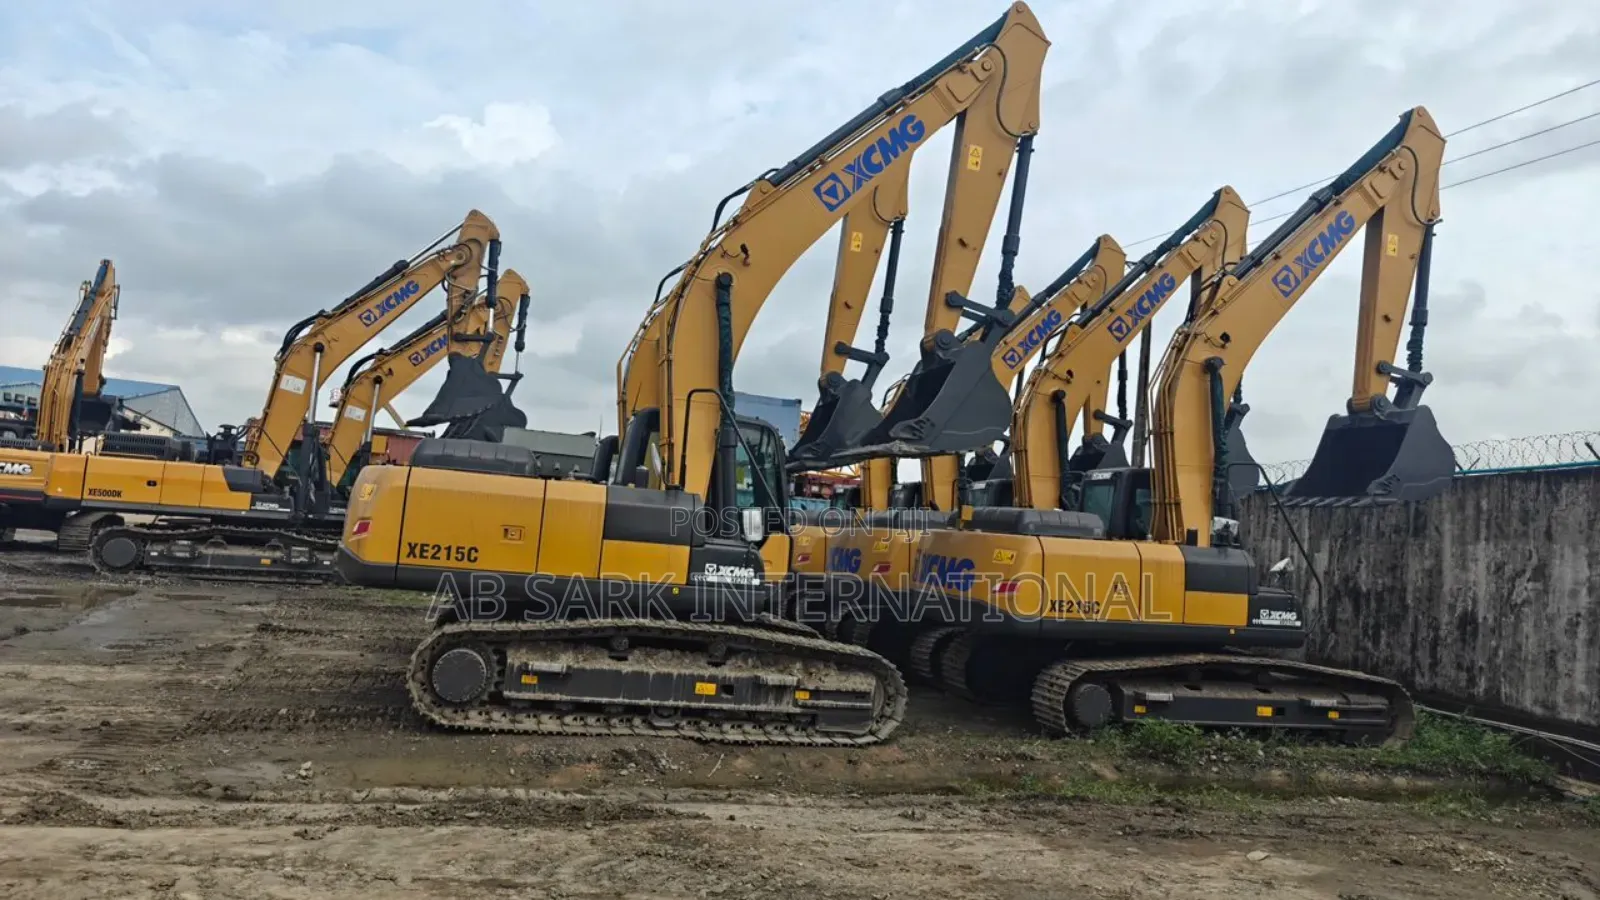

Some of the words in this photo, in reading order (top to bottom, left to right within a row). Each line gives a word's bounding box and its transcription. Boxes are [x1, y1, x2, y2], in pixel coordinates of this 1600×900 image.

[842, 114, 925, 194] XCMG
[1294, 210, 1356, 279] XCMG
[376, 280, 420, 316] XCMG
[1126, 272, 1176, 328] XCMG
[1018, 309, 1062, 356] XCMG
[423, 333, 449, 360] XCM
[88, 488, 122, 498] XE500DK
[406, 542, 479, 563] XE215C
[716, 565, 755, 577] XCMG
[1049, 599, 1100, 615] XE215C
[1270, 610, 1297, 620] XCMG
